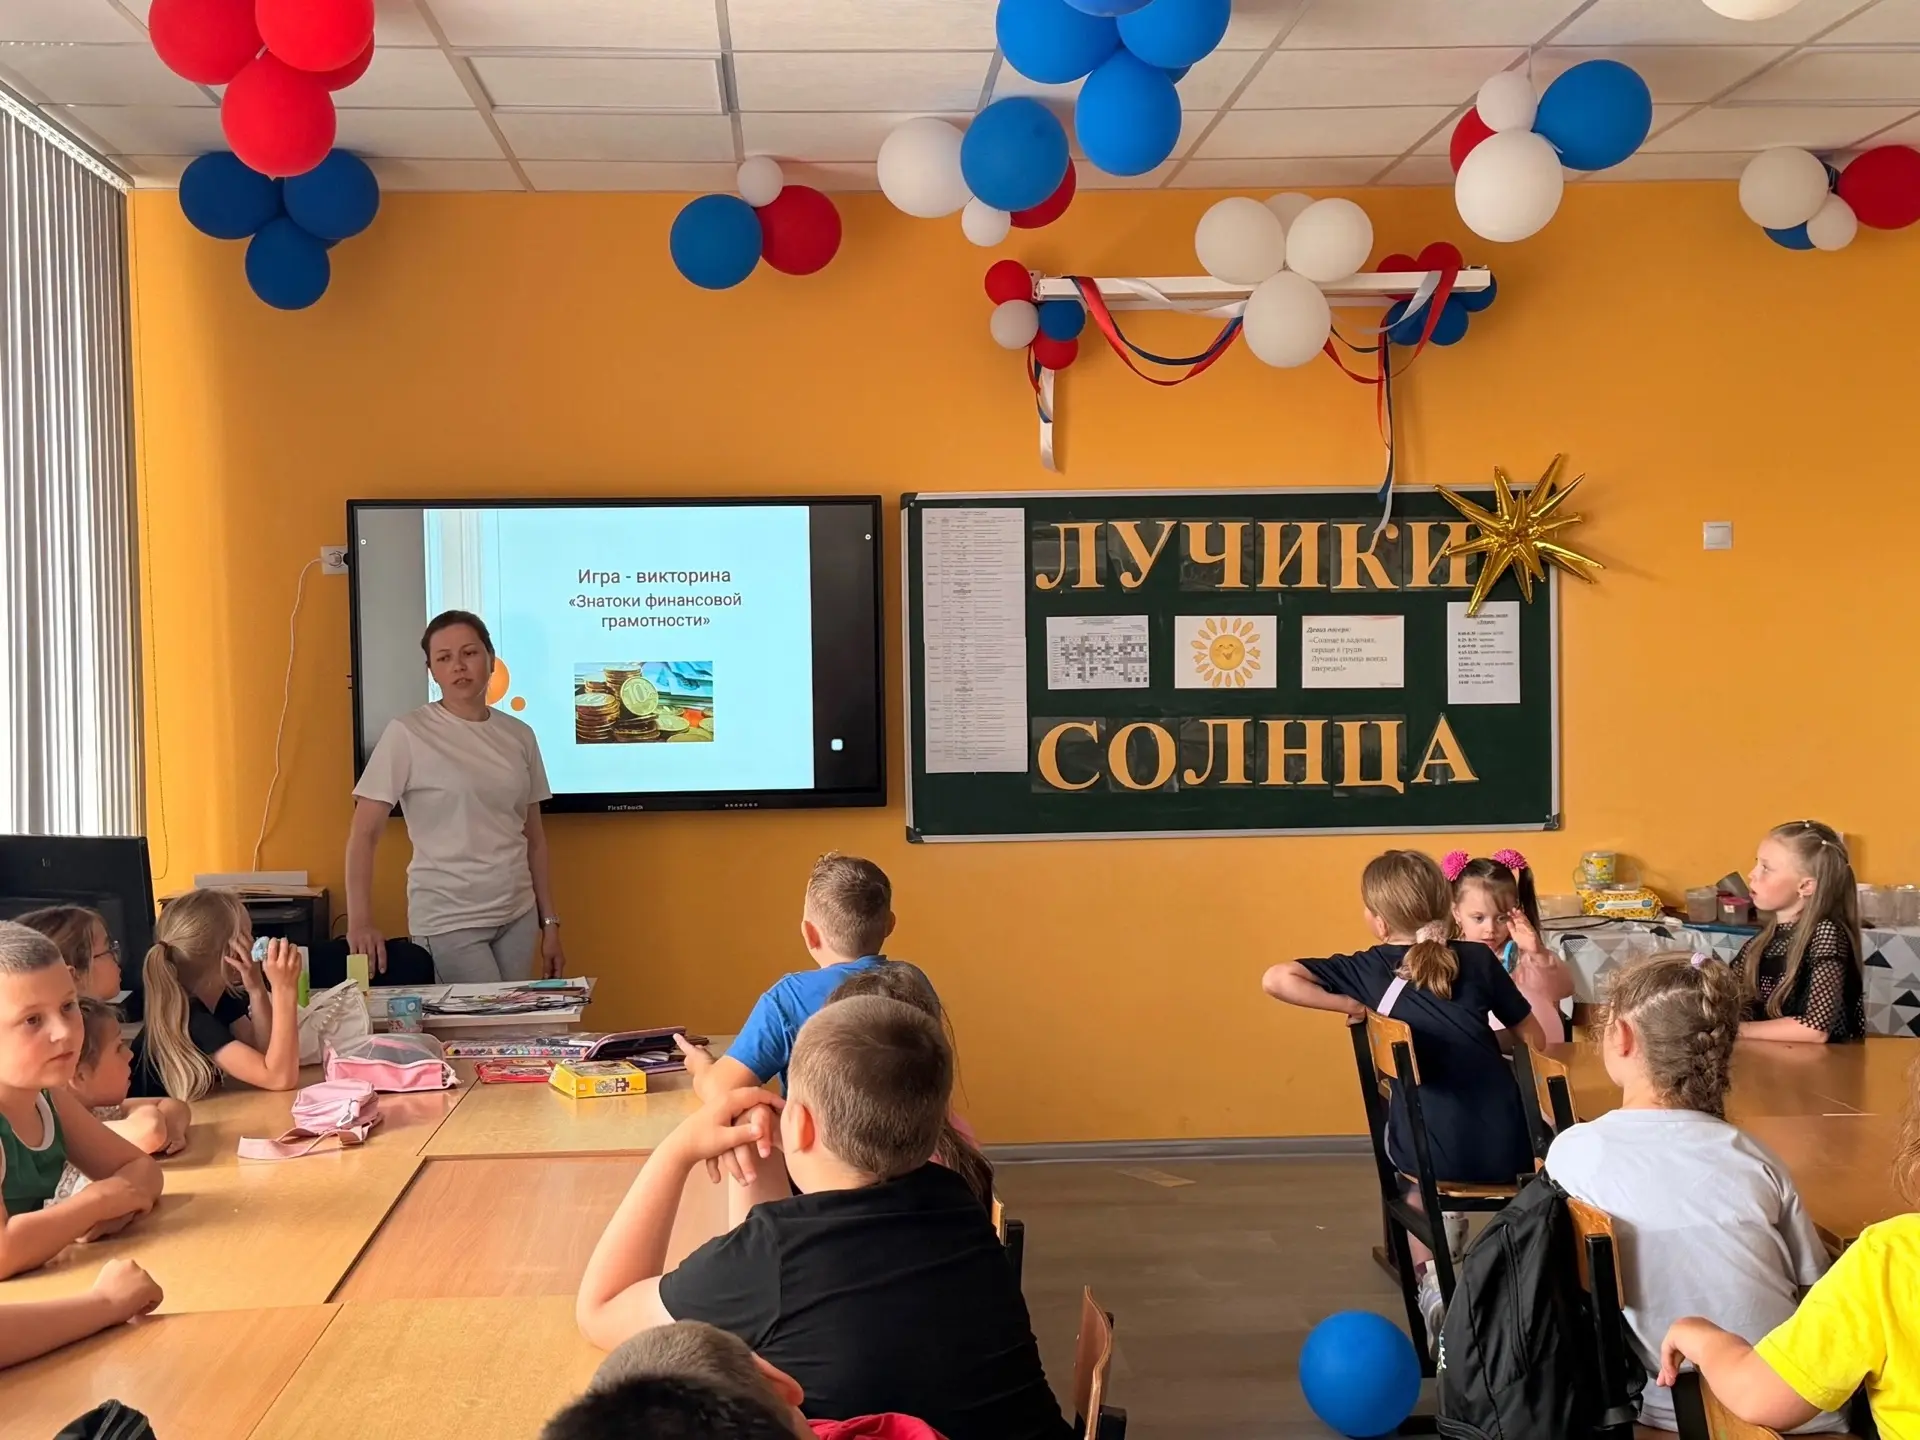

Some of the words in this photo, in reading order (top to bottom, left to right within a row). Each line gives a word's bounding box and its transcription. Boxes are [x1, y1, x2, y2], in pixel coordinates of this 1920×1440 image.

[1035, 520, 1476, 590] ЛУЧИКИ
[578, 569, 621, 587] Игра
[636, 570, 731, 586] викторина
[568, 594, 641, 608] «Знатоки
[645, 592, 742, 610] финансовой
[601, 615, 711, 631] грамотности»
[1037, 713, 1480, 795] СОЛНЦА
